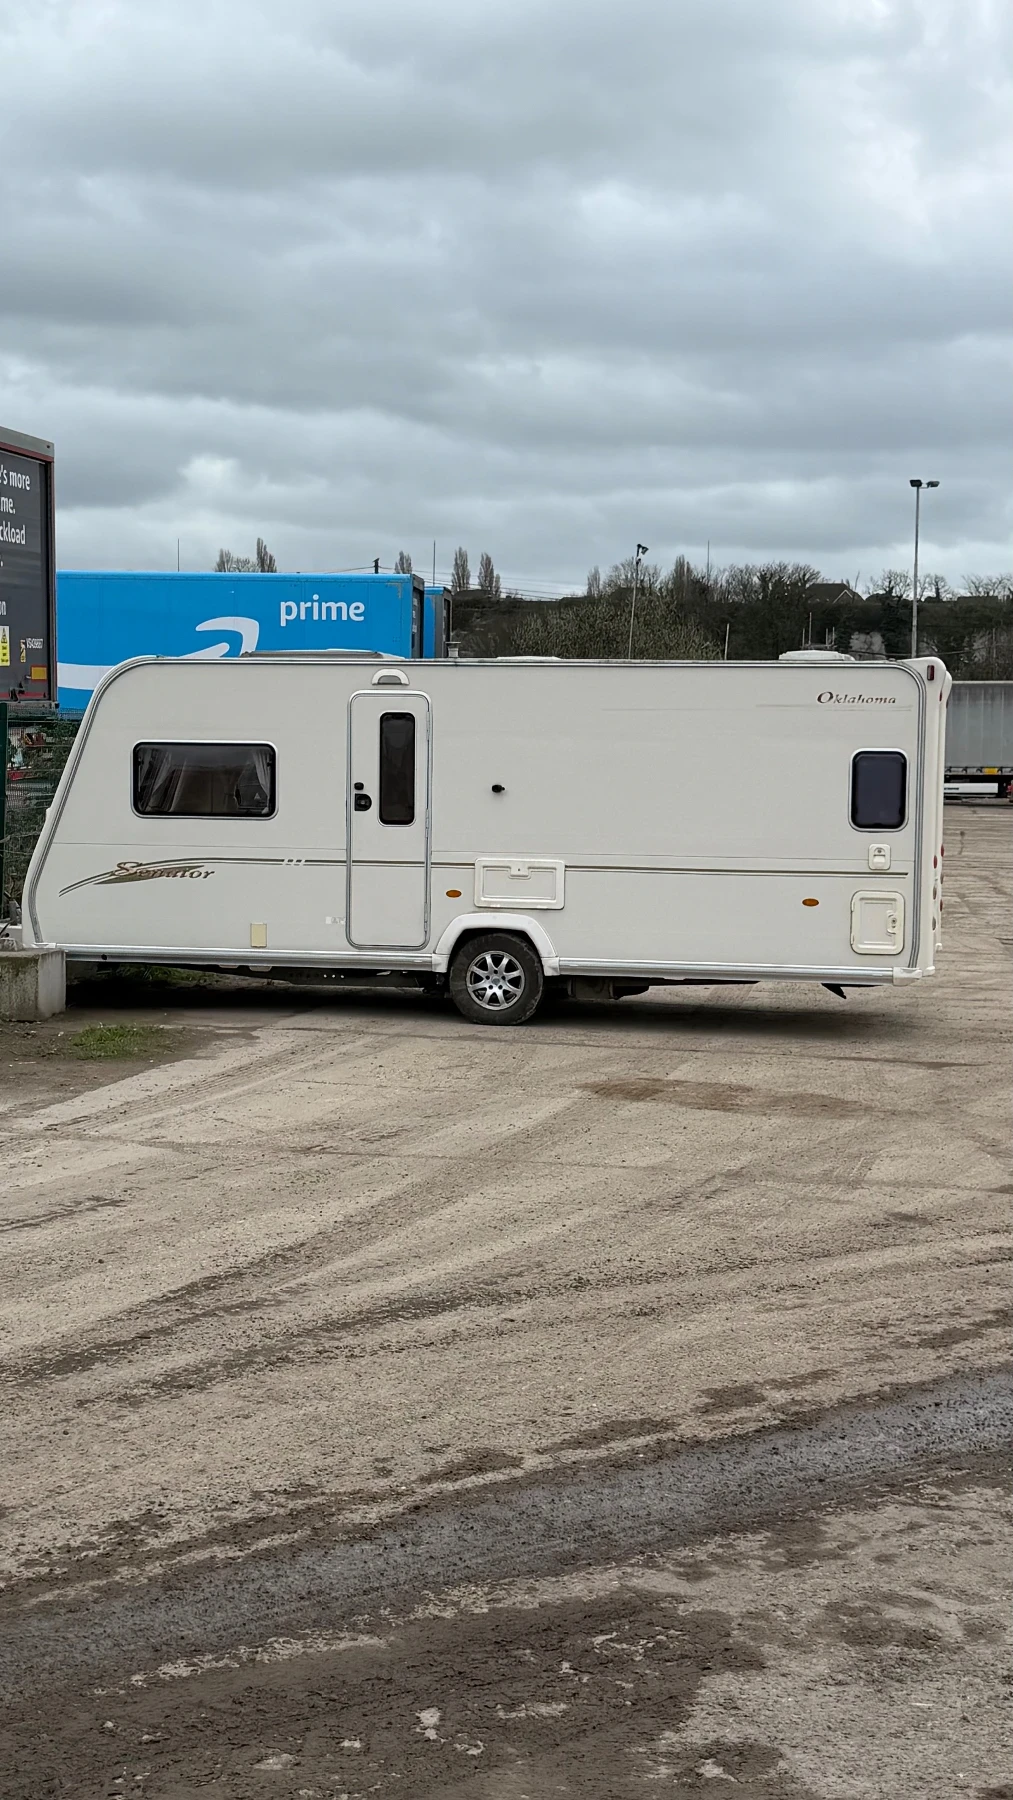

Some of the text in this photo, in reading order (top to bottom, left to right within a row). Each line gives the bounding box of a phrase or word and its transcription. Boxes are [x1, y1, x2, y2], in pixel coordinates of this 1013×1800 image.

[9, 471, 31, 491] more
[280, 594, 365, 627] prime
[817, 691, 897, 704] Oklahoma
